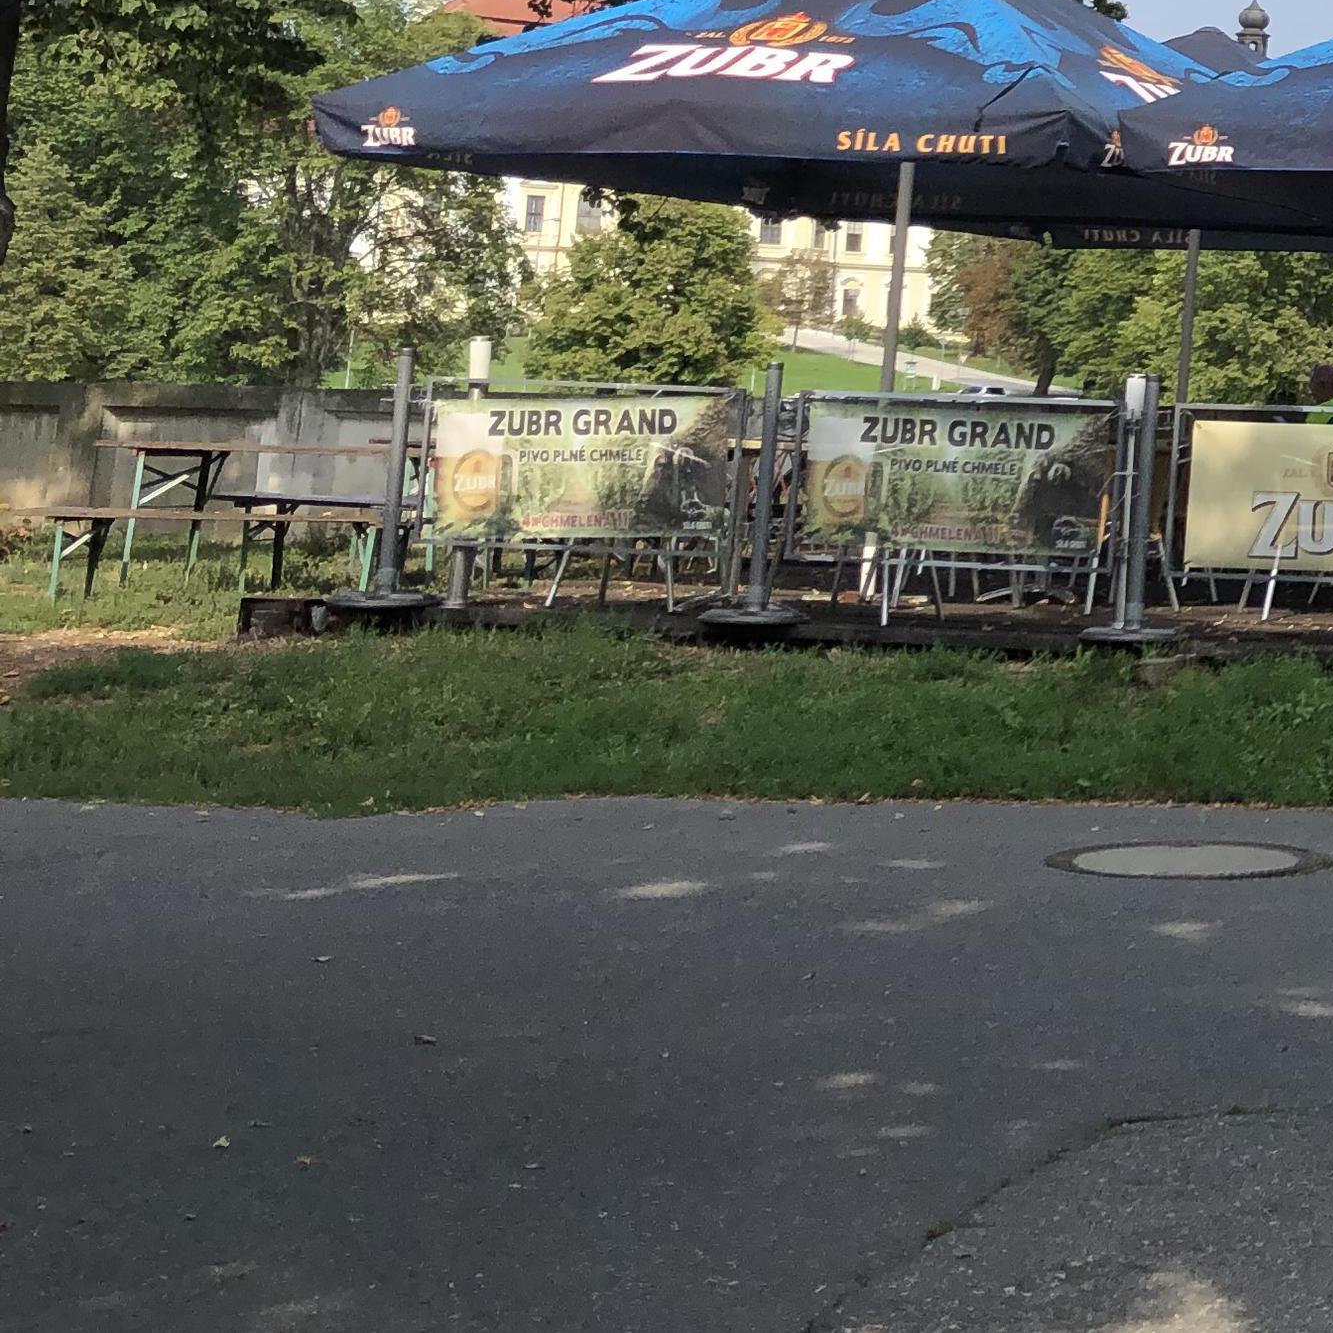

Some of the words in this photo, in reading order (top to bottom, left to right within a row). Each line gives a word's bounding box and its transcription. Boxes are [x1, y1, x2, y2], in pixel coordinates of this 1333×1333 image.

[590, 43, 855, 84] ZUBR
[361, 125, 416, 147] ZUBR
[837, 128, 901, 152] SÍLA
[916, 134, 1007, 155] CHUTI
[1100, 143, 1125, 167] ZU
[1168, 142, 1235, 166] ZUBR
[488, 409, 562, 437] ZUBR
[572, 408, 677, 436] GRAND
[860, 416, 937, 446] ZUBR
[948, 420, 1055, 451] GRAND
[519, 449, 550, 462] PIVO
[553, 445, 586, 462] PLNÉ
[590, 449, 642, 462] CHMELE
[890, 458, 922, 473] PIVO
[926, 456, 958, 474] PLNÉ
[962, 460, 1016, 475] CHMELE
[454, 474, 497, 492] ZUBR
